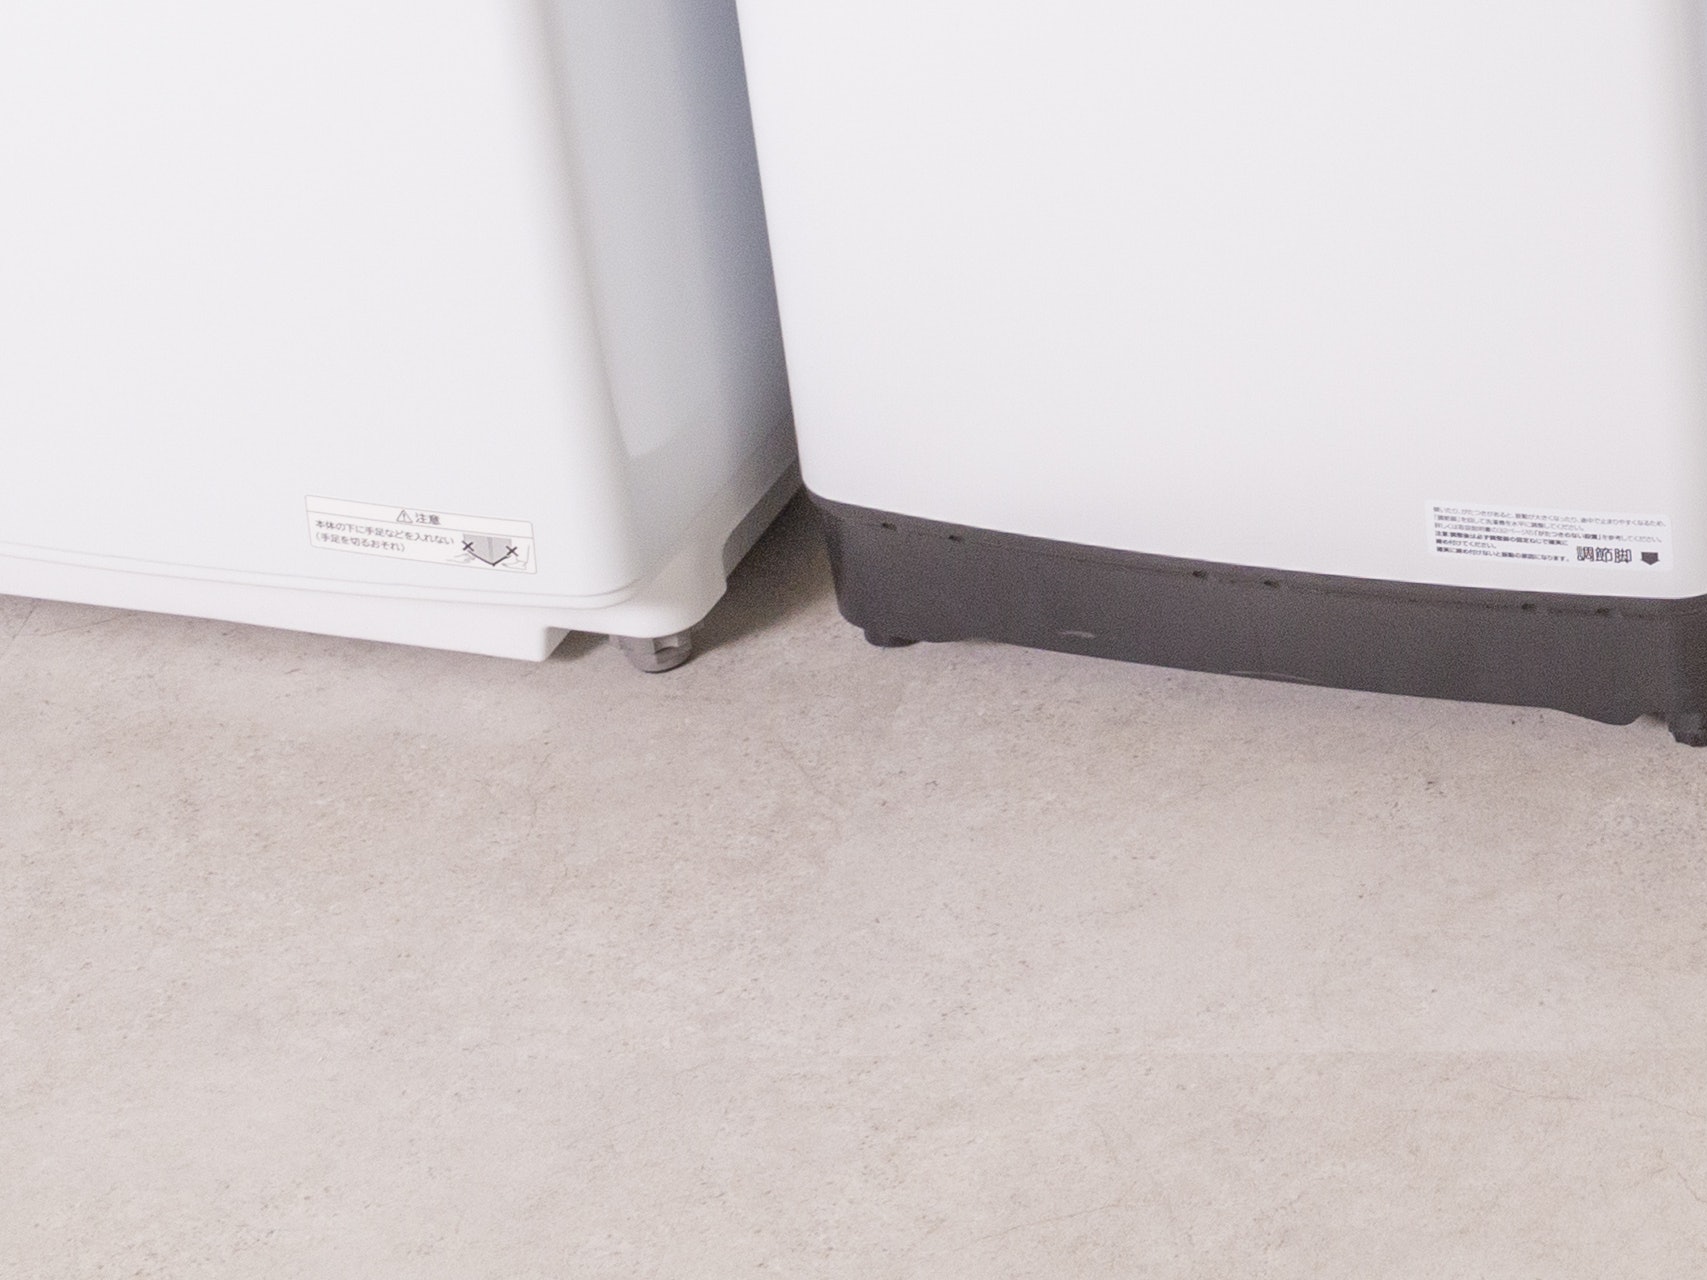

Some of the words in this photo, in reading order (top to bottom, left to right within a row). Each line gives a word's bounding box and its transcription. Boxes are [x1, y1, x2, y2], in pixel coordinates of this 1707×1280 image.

[415, 513, 441, 526] 注意
[315, 520, 455, 545] 本体の下に手足などを入れない
[1576, 545, 1633, 564] 調節脚
